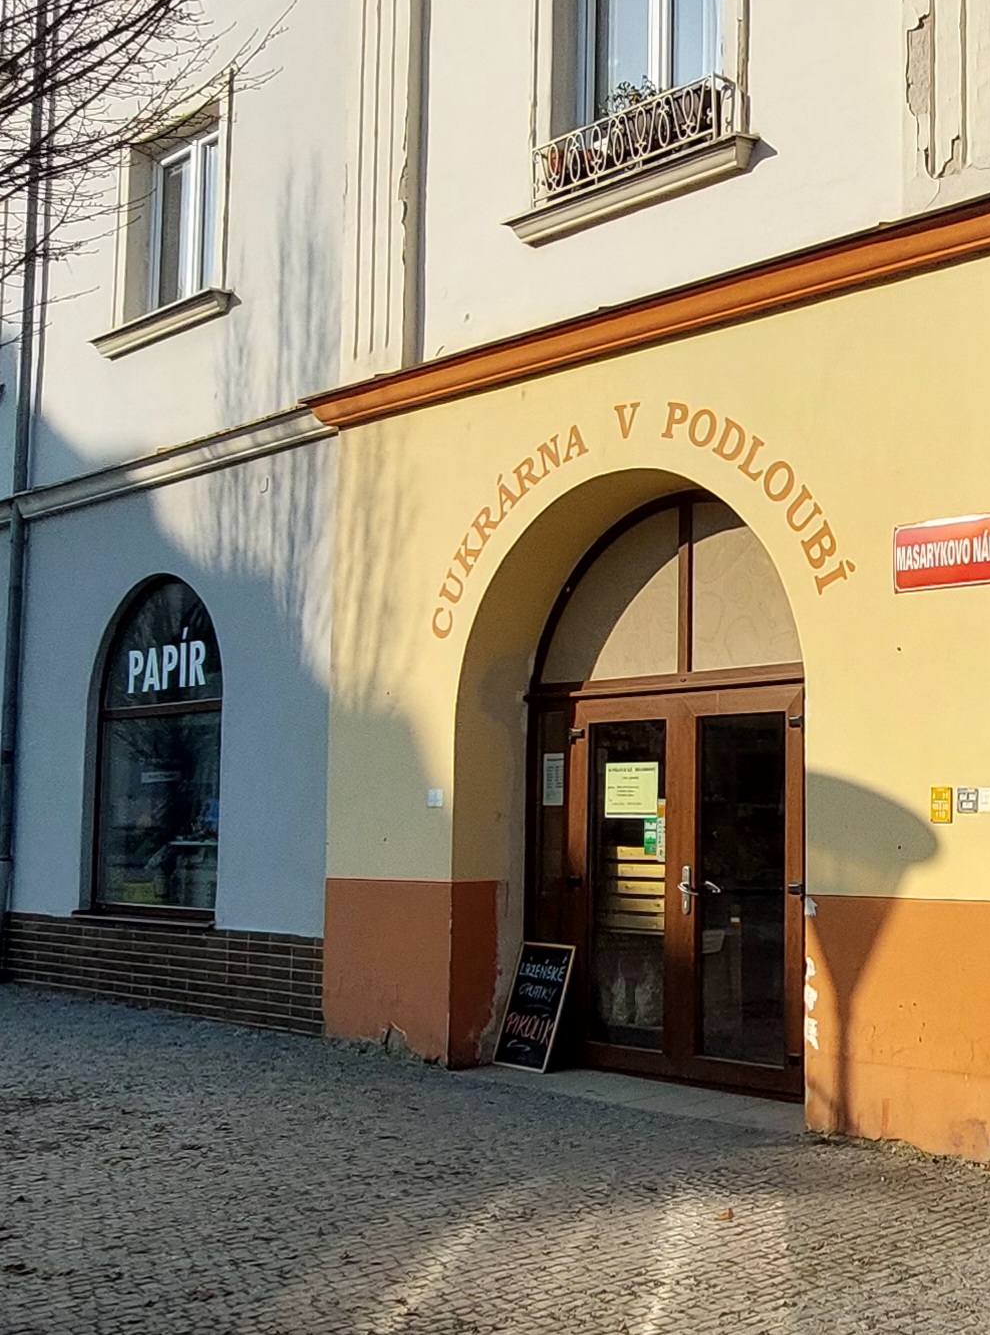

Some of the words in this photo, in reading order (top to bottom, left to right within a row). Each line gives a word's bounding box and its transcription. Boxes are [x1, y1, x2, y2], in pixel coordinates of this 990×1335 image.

[431, 423, 589, 639] CUKRÁRNA
[613, 401, 641, 440] V
[660, 401, 857, 596] PODLOUBÍ
[896, 539, 971, 572] MASARYKOVO
[127, 626, 206, 694] PAPÍR
